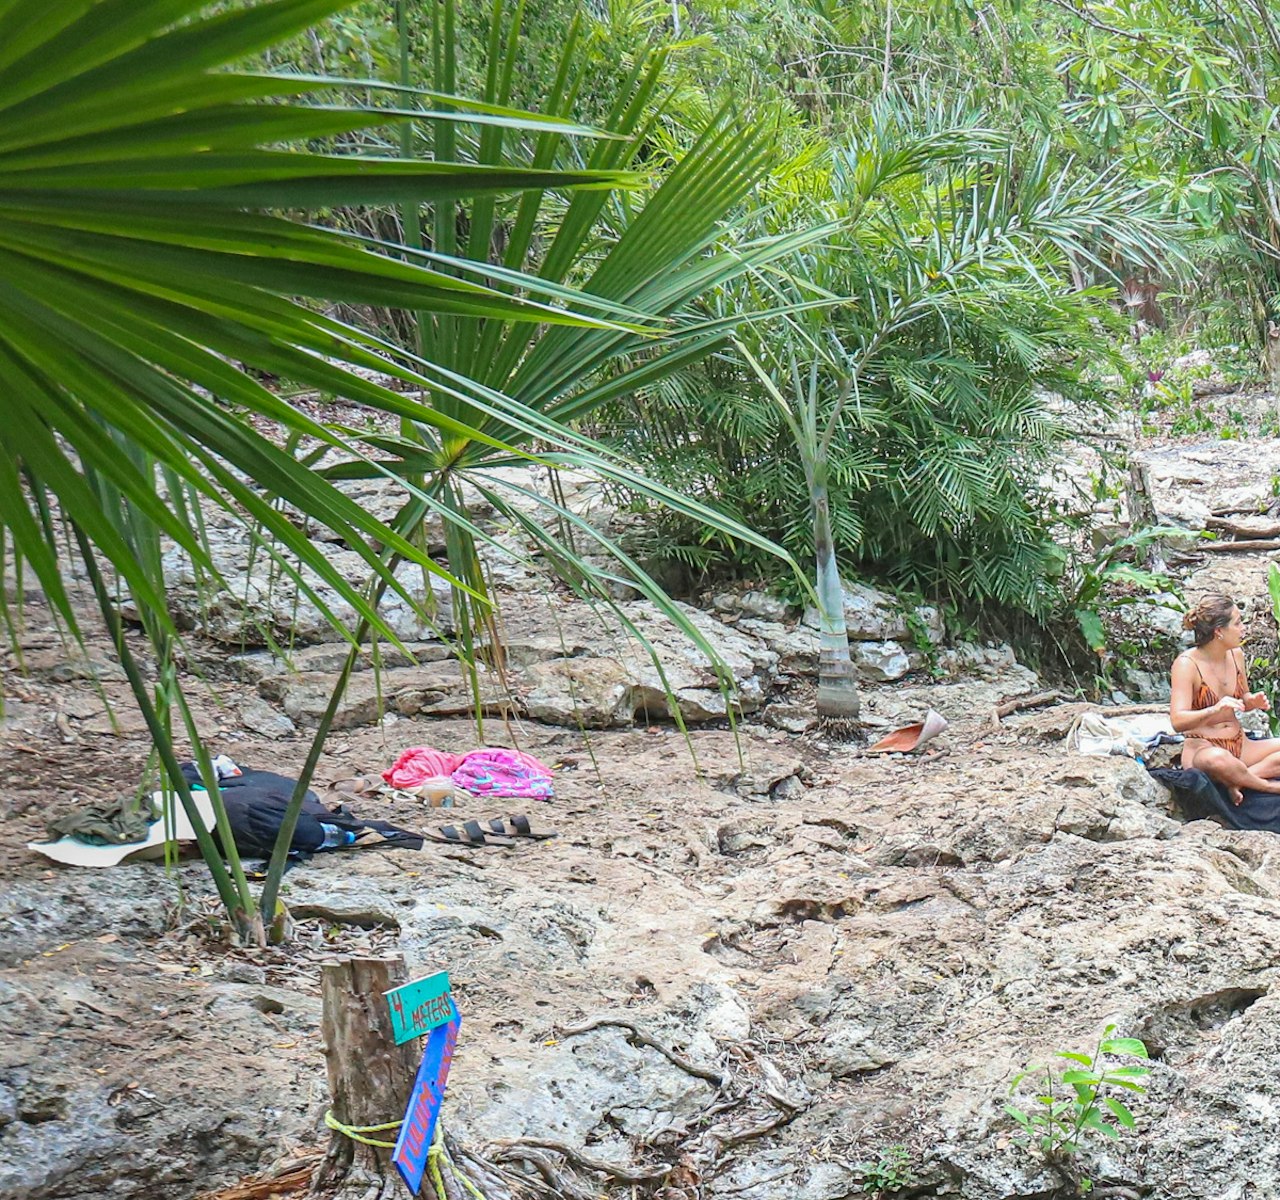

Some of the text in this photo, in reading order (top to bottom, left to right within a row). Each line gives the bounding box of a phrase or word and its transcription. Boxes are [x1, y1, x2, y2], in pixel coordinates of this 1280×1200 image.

[391, 991, 407, 1031] 4
[411, 991, 452, 1032] METERS
[398, 1082, 437, 1174] TULUM
